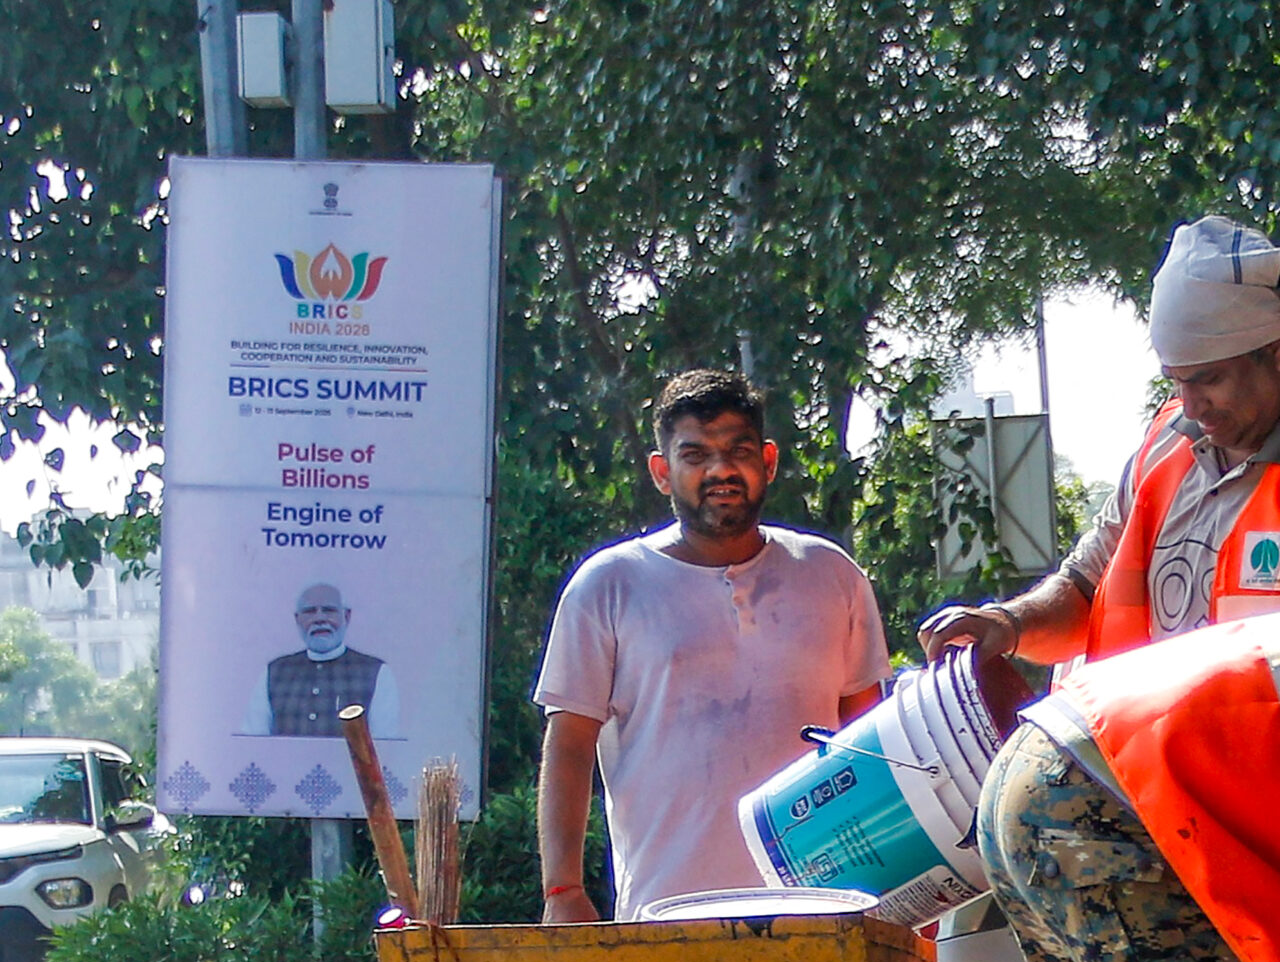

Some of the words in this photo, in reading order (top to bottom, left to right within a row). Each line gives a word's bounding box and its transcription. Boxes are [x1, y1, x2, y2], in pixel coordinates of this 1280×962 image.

[297, 303, 363, 319] BRICS
[289, 322, 330, 335] INDIA
[231, 340, 278, 351] BUILDING
[281, 342, 301, 351] FOR
[303, 342, 359, 353] RESILIENCE,
[364, 345, 428, 356] INNOVATION,
[240, 352, 313, 363] COOPERATION
[315, 353, 338, 364] AND
[339, 354, 417, 366] SUSTAINABILITY
[228, 376, 309, 399] BRICS
[316, 379, 428, 402] SUMMIT
[277, 443, 343, 463] Pulse
[350, 444, 376, 464] of
[281, 468, 370, 490] Billions
[267, 502, 350, 526] Engine
[358, 504, 384, 524] of
[262, 528, 387, 550] Tomorrow
